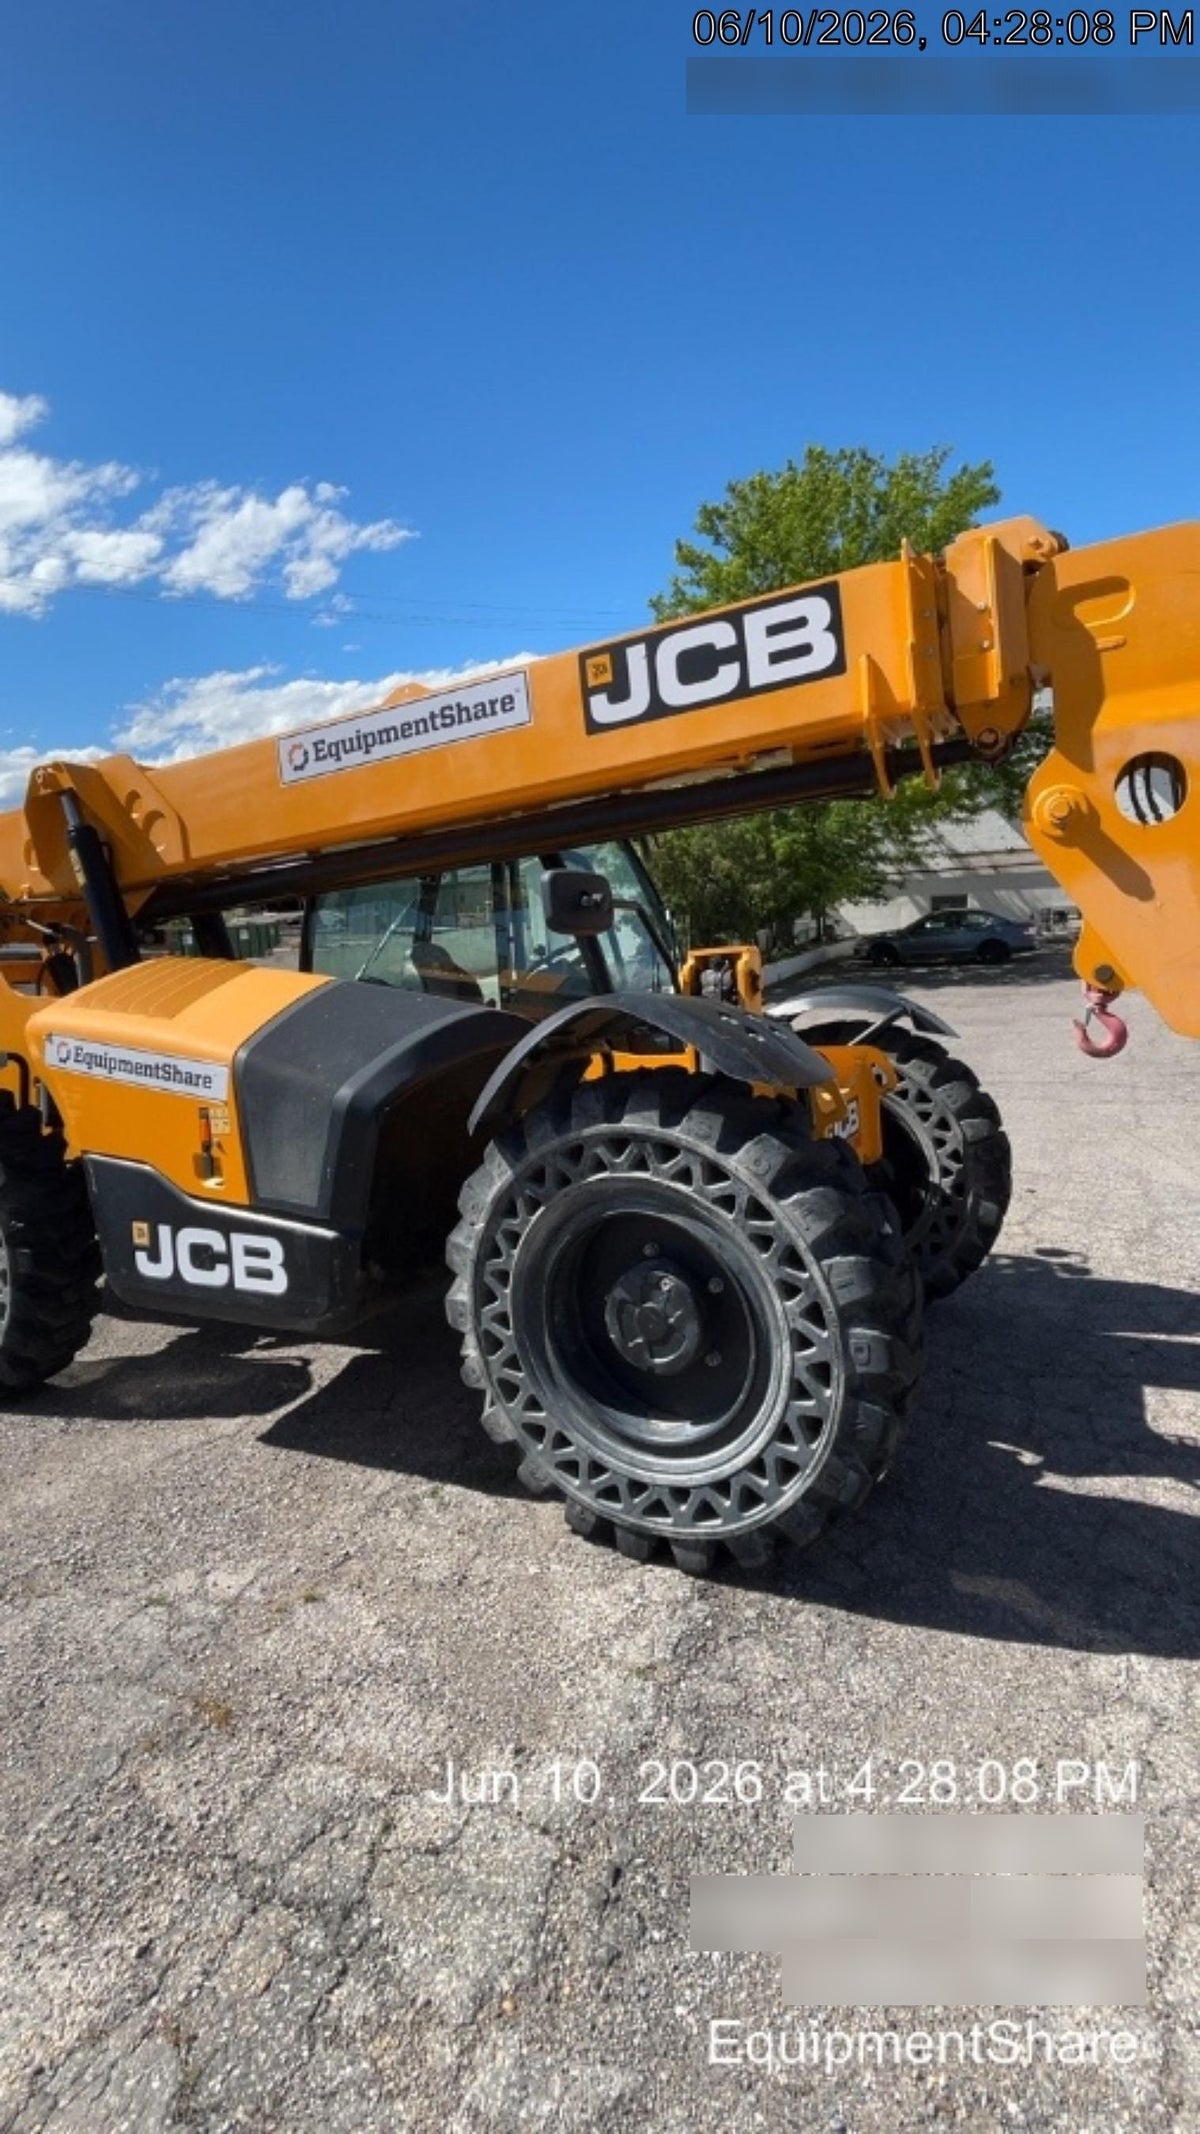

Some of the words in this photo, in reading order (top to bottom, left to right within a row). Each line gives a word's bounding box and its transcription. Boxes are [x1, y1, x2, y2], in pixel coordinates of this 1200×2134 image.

[588, 595, 838, 724] JCB
[312, 693, 515, 763] EquipmentShare
[72, 1045, 213, 1090] EquipmentShare
[134, 1223, 288, 1295] JCB
